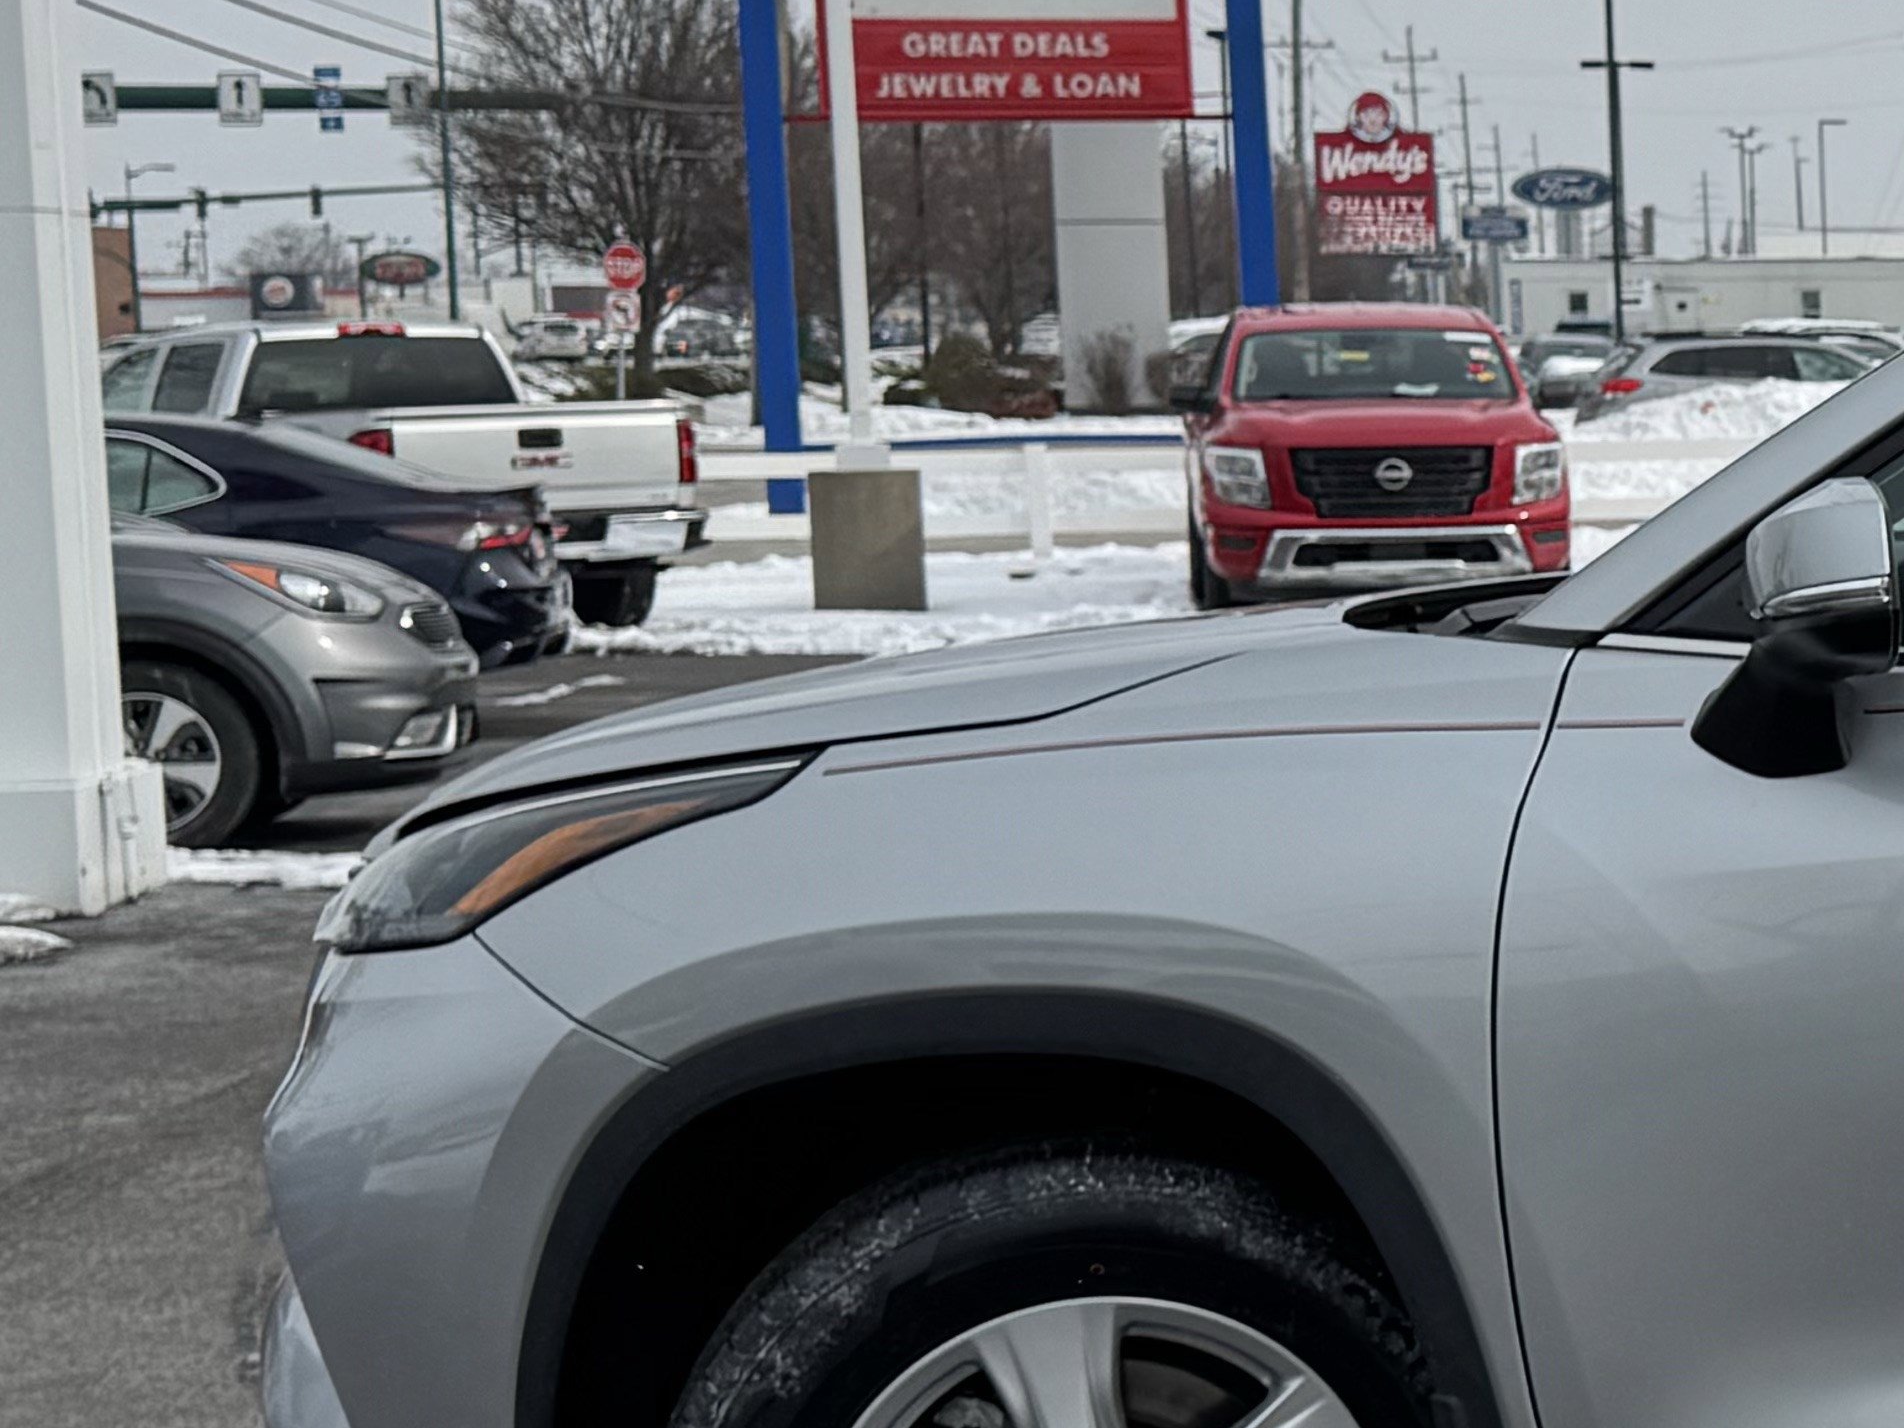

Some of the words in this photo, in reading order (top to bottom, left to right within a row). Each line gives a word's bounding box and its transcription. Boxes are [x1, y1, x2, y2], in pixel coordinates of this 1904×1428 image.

[902, 31, 1003, 59] GREAT
[1013, 31, 1110, 59] DEALS
[875, 73, 1011, 99] JEWELRY
[1019, 74, 1043, 99] &
[1053, 73, 1142, 99] LOAN
[1532, 174, 1598, 203] Ford
[1325, 195, 1427, 215] QUALITY
